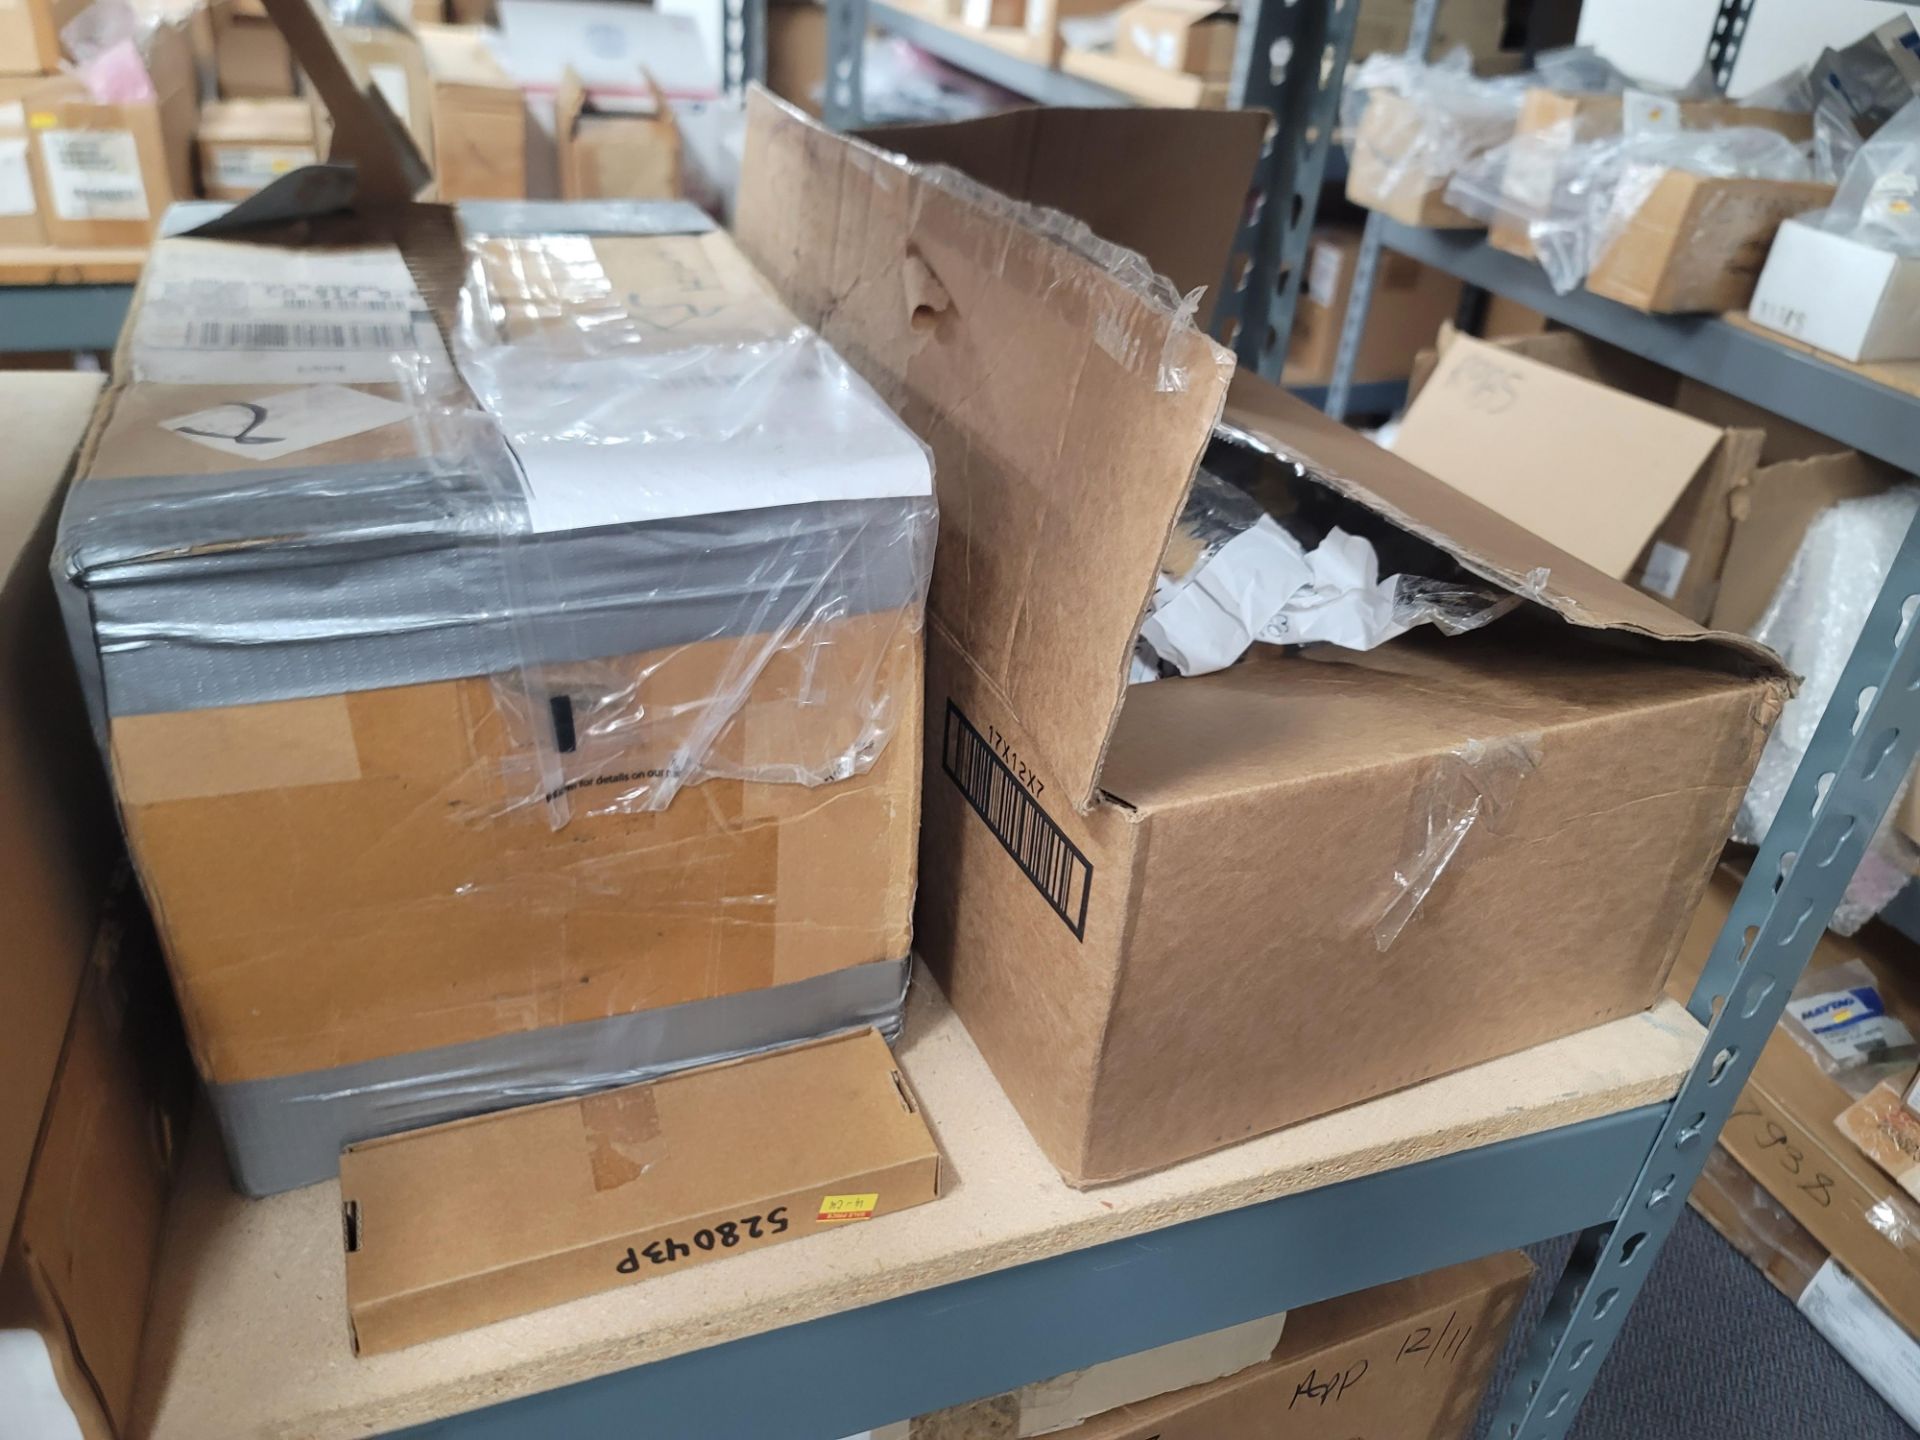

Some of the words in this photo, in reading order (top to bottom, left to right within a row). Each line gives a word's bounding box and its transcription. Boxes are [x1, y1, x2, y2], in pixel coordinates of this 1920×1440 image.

[578, 775, 594, 787] for
[596, 772, 630, 785] details
[632, 771, 646, 780] on
[646, 769, 665, 778] our
[988, 725, 1045, 799] 17X12X7
[1802, 997, 1856, 1021] MAYTAG
[615, 1206, 790, 1275] 528043P
